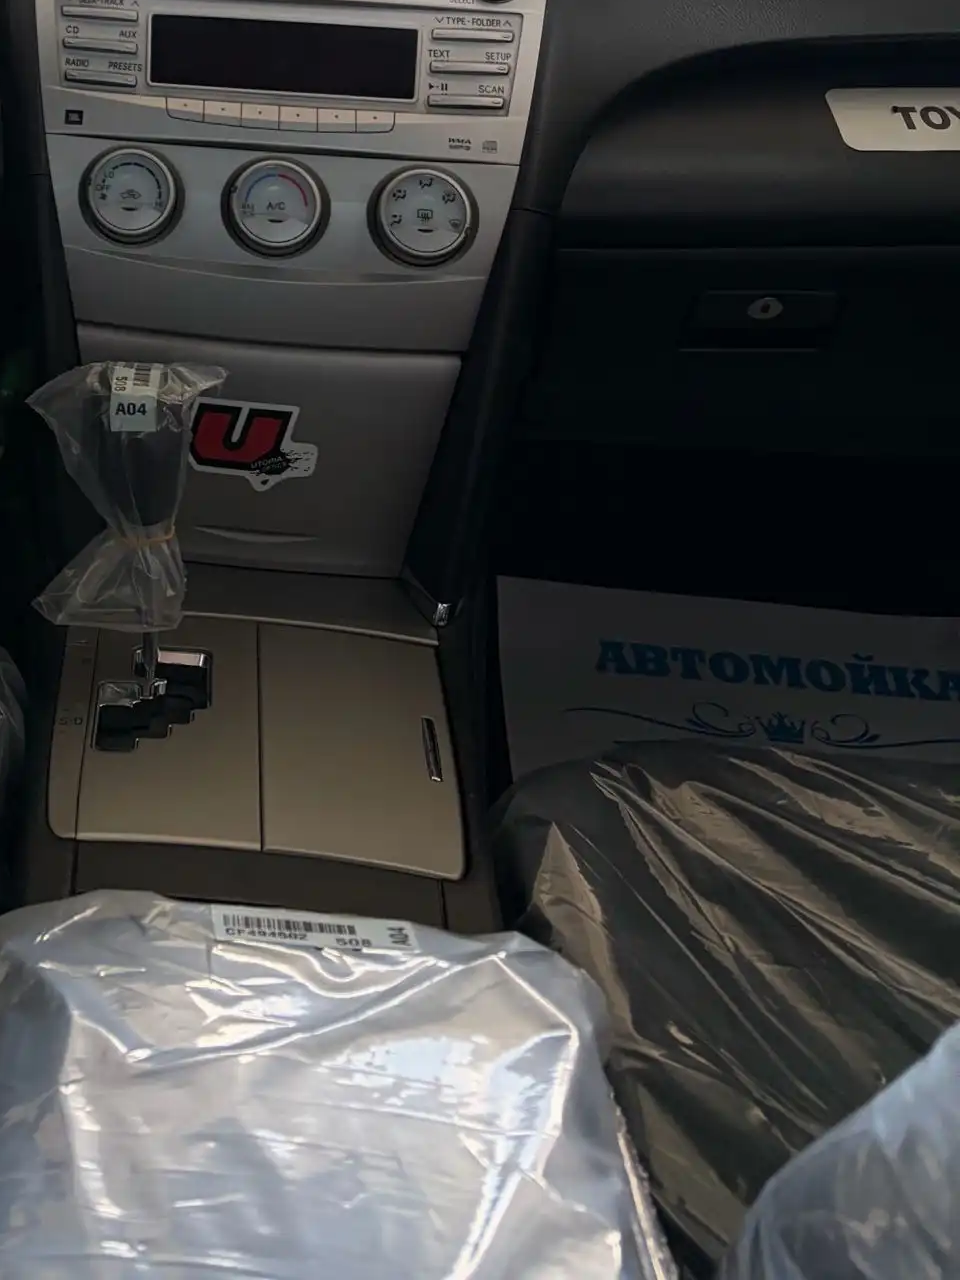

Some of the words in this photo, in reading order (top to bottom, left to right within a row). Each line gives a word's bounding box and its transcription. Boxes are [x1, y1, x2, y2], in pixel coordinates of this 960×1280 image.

[65, 25, 80, 34] CD
[119, 30, 137, 38] AUX
[427, 49, 451, 58] TEXT
[485, 51, 512, 61] SETUP
[64, 57, 89, 67] RADIO
[108, 61, 143, 72] PRESETS
[478, 84, 505, 94] SCAN
[266, 201, 286, 210] A/C
[114, 376, 128, 392] 508
[114, 401, 147, 416] A04
[335, 937, 372, 948] 508
